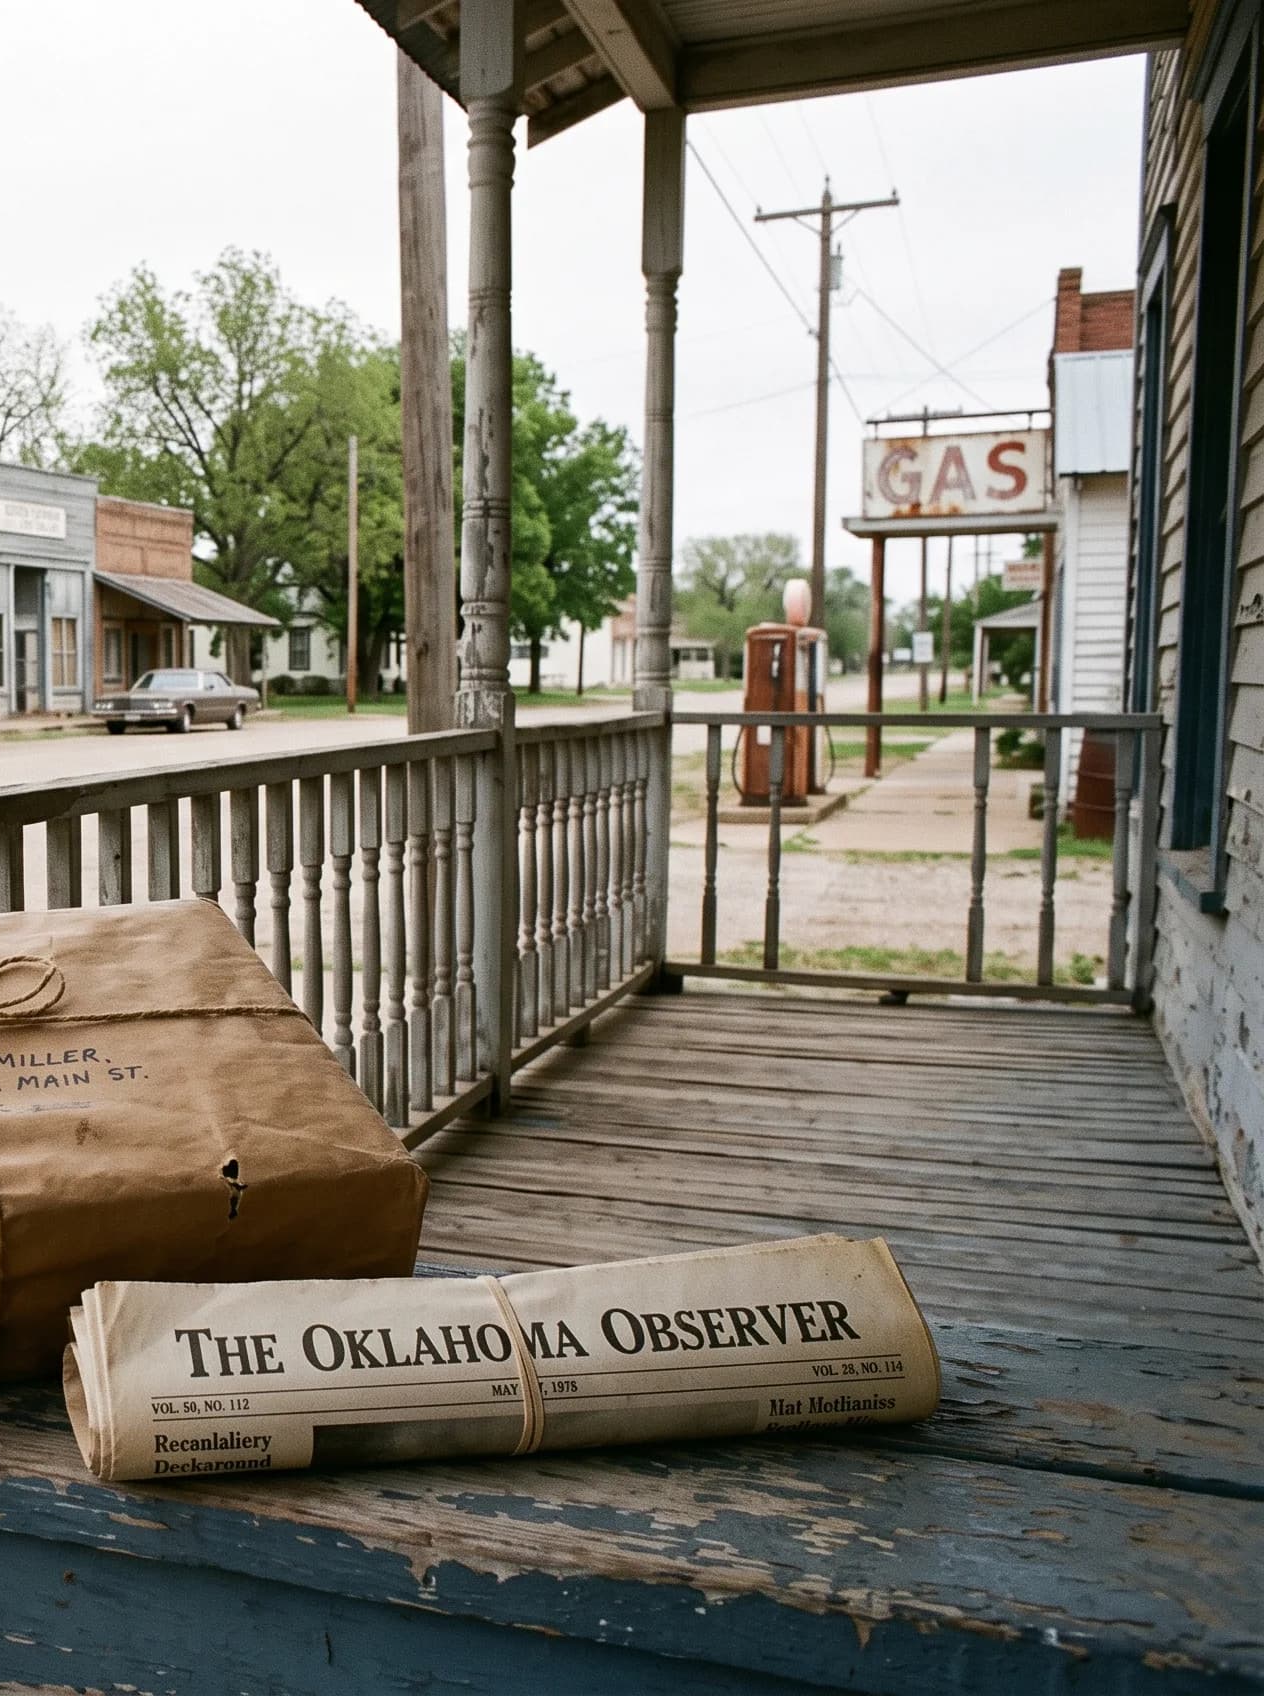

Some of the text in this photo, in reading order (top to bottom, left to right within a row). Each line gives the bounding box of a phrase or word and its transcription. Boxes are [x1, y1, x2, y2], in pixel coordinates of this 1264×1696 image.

[877, 441, 1027, 506] GAS
[16, 1070, 90, 1091] MAIN
[107, 1065, 148, 1081] ST.
[174, 1327, 285, 1379] THE
[600, 1300, 862, 1356] OBSERVER
[841, 1363, 859, 1376] 28,
[861, 1361, 882, 1374] NO.
[885, 1360, 903, 1372] 114
[491, 1383, 519, 1397] MAY
[151, 1398, 250, 1415] VOL. 50, NO. 112
